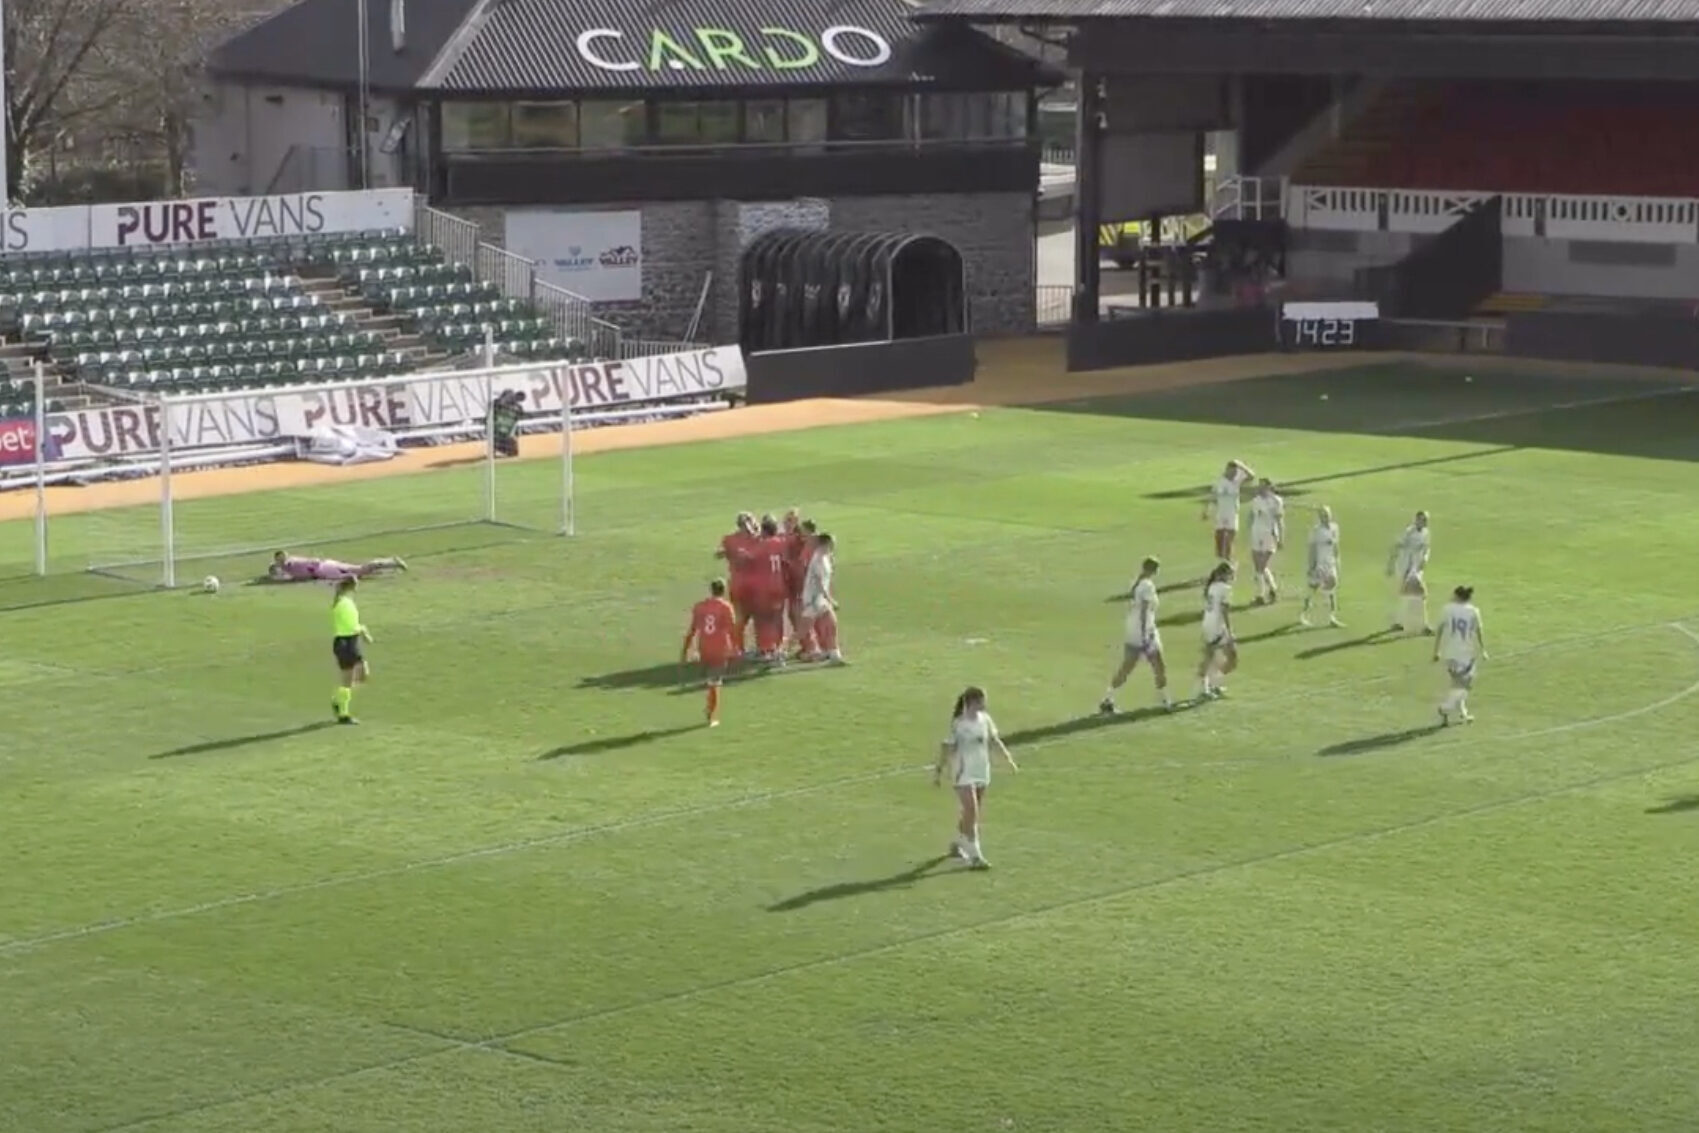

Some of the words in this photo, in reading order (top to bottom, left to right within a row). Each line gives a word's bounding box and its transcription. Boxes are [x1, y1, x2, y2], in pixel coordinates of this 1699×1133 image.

[576, 25, 892, 71] CARDO
[0, 211, 28, 250] S
[117, 201, 217, 245] PURE
[229, 195, 325, 236] VANS
[1296, 319, 1354, 344] 1423
[527, 362, 629, 408] PURE
[623, 351, 723, 396] VANS
[301, 383, 410, 428] PURE
[411, 375, 499, 422] VAN
[0, 426, 33, 451] et
[44, 406, 173, 457] PURE
[172, 398, 280, 444] VANS
[769, 554, 781, 573] 11
[704, 614, 716, 635] 8
[1451, 617, 1467, 641] 19
